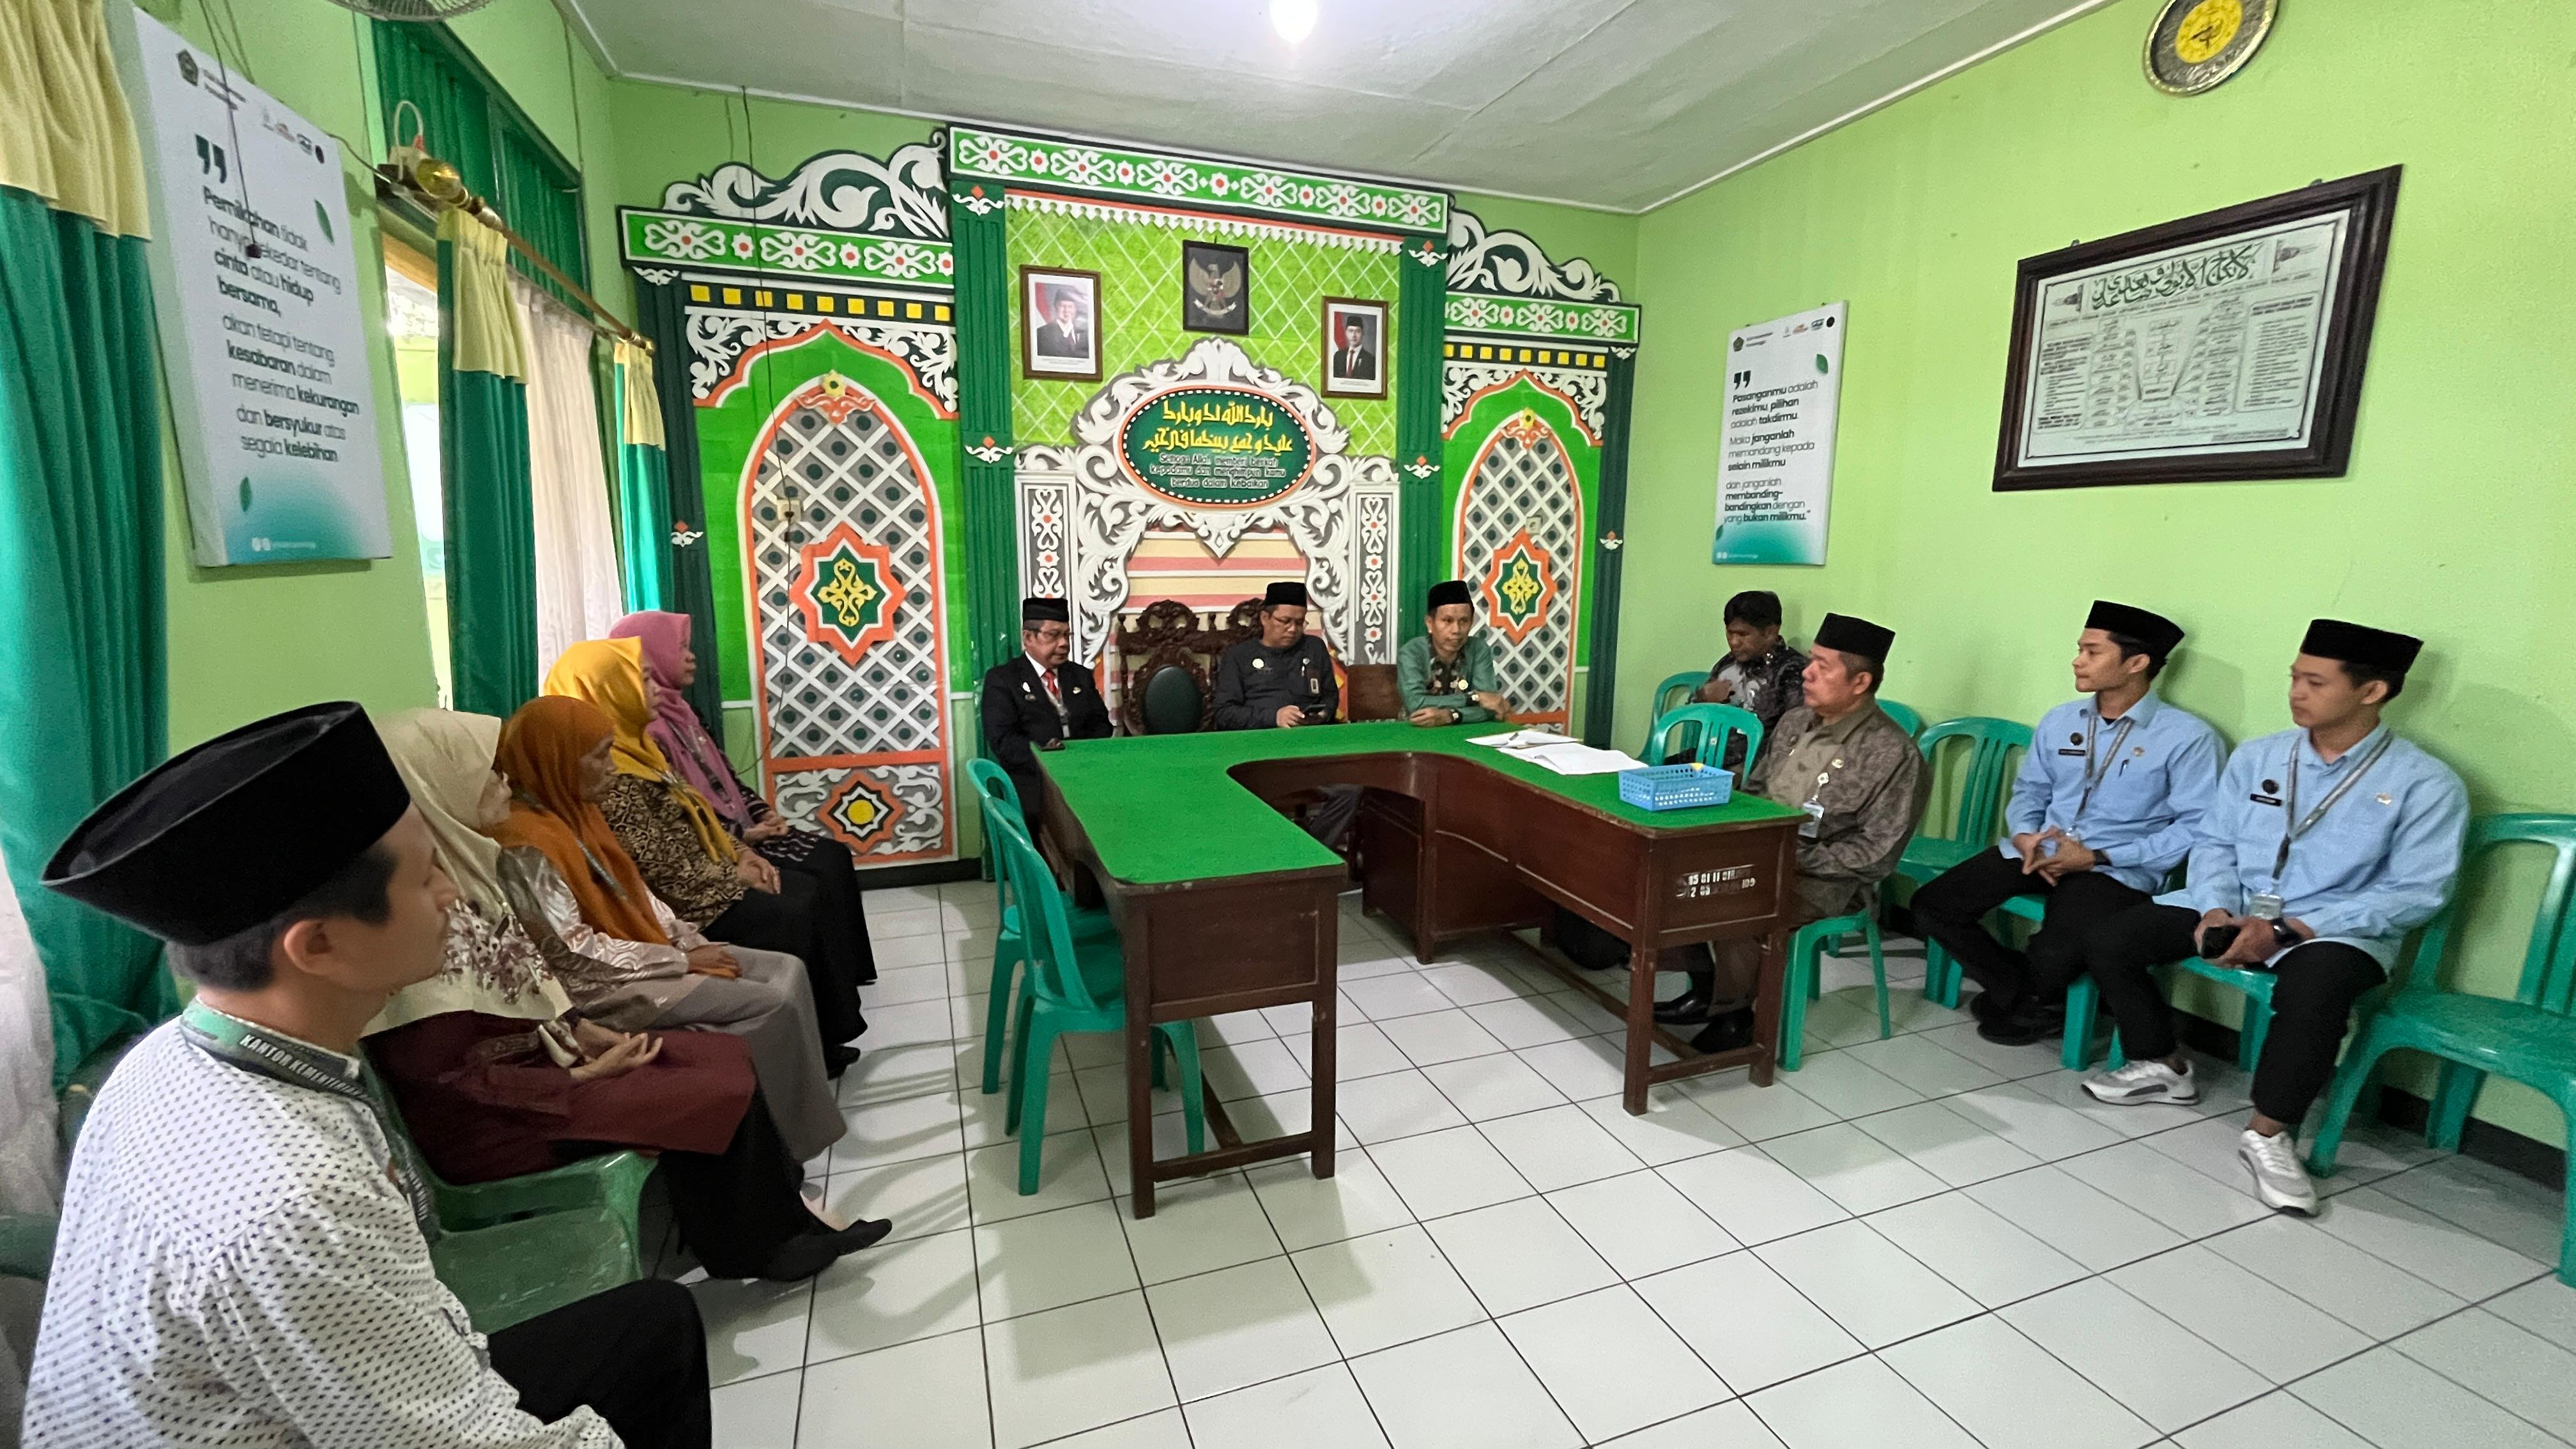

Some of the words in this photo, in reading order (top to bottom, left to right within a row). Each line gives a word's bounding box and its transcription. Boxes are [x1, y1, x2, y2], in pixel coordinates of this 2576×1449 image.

[214, 248, 249, 276] cinta
[280, 273, 314, 307] hidup
[226, 339, 296, 376] kesabaran
[1732, 387, 1787, 402] Pasanganmu
[1788, 379, 1818, 394] adalah
[296, 385, 360, 417] kekurangan
[236, 404, 263, 425] dan
[263, 408, 323, 438] bersyukur
[1750, 429, 1795, 445] janganlah
[1728, 445, 1781, 458] memandang
[1782, 441, 1815, 456] kepada
[1195, 466, 1211, 477] dan
[1214, 467, 1262, 479] menghimpun
[1264, 468, 1287, 478] kamu
[1728, 459, 1751, 471] selain
[1752, 458, 1786, 470] milikmu
[1201, 478, 1228, 489] dalam
[1229, 479, 1269, 489] kebaikan
[1726, 480, 1741, 490] dan
[1724, 501, 1772, 514] bandingkan
[1772, 500, 1805, 512] dengan
[1743, 513, 1769, 522] bukan
[238, 1033, 291, 1067] KANTOR
